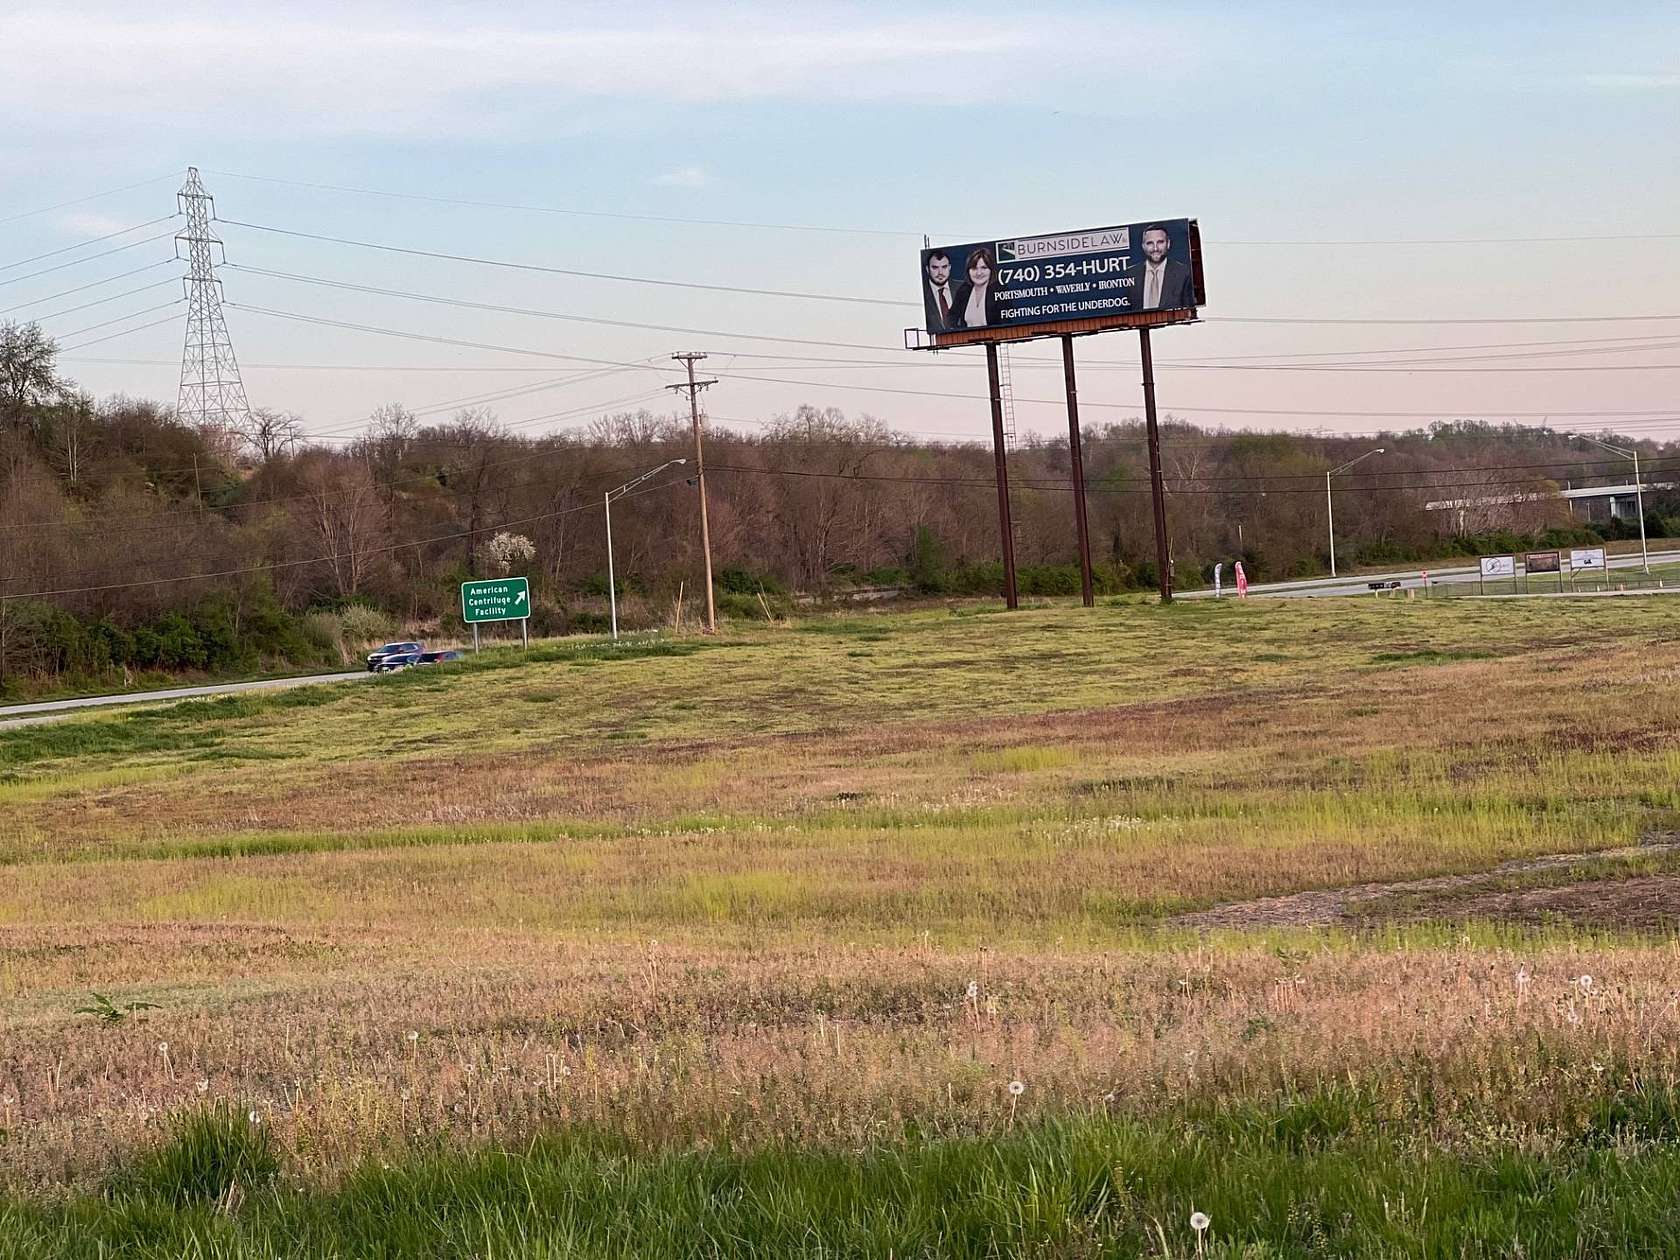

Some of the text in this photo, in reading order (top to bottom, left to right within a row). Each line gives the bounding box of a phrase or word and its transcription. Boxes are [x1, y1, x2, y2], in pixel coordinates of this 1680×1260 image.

[998, 256, 1131, 285] (740) 354-HURT
[994, 277, 1135, 301] PORTSMOUTH WAVERLY IRONTON
[1000, 297, 1131, 319] FIGHTING FOR THE UNDERDOG.
[470, 586, 508, 596] American
[468, 596, 511, 606] Centrifuge
[475, 607, 506, 616] Facility
